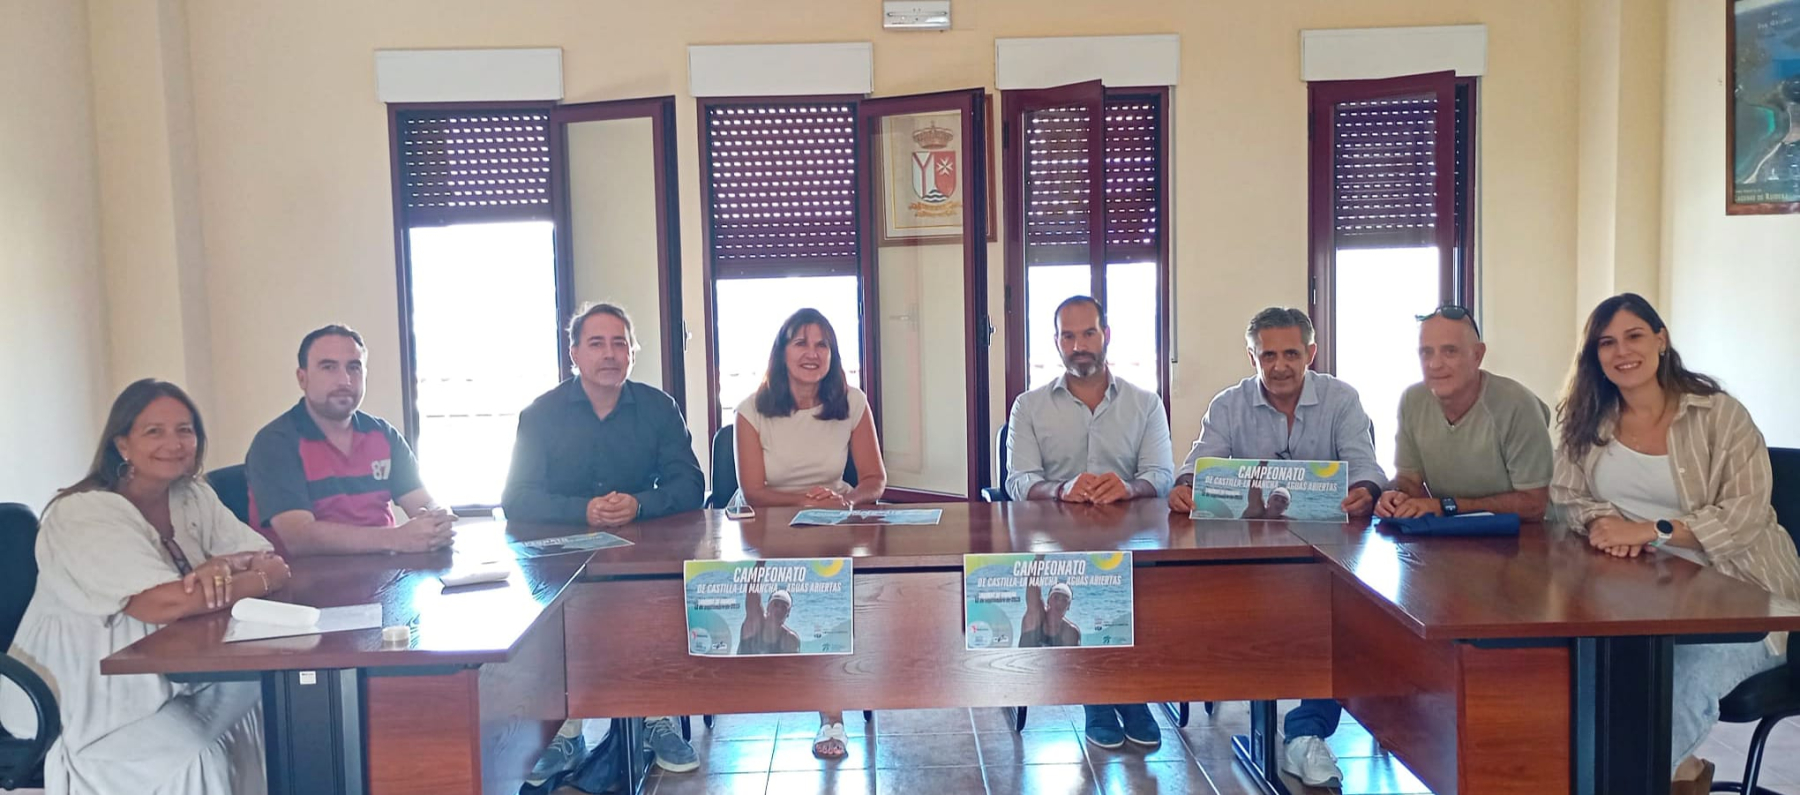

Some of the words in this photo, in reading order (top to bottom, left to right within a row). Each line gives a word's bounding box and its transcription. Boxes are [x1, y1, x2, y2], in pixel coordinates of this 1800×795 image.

[371, 458, 391, 480] 87
[1237, 465, 1306, 481] CAMPEONATO
[1205, 475, 1214, 484] DE
[1286, 481, 1308, 490] AGUAS
[1308, 481, 1338, 491] ABIERTAS
[733, 566, 807, 583] CAMPEONATO
[1013, 560, 1086, 577] CAMPEONATO
[697, 584, 707, 594] DE
[748, 583, 778, 594] MANCHA
[786, 582, 810, 593] AGUAS
[809, 581, 842, 593] ABIERTAS
[977, 577, 988, 588] DE
[1028, 575, 1058, 587] MANCHA
[1066, 575, 1089, 586] AGUAS
[1089, 575, 1122, 586] ABIERTAS
